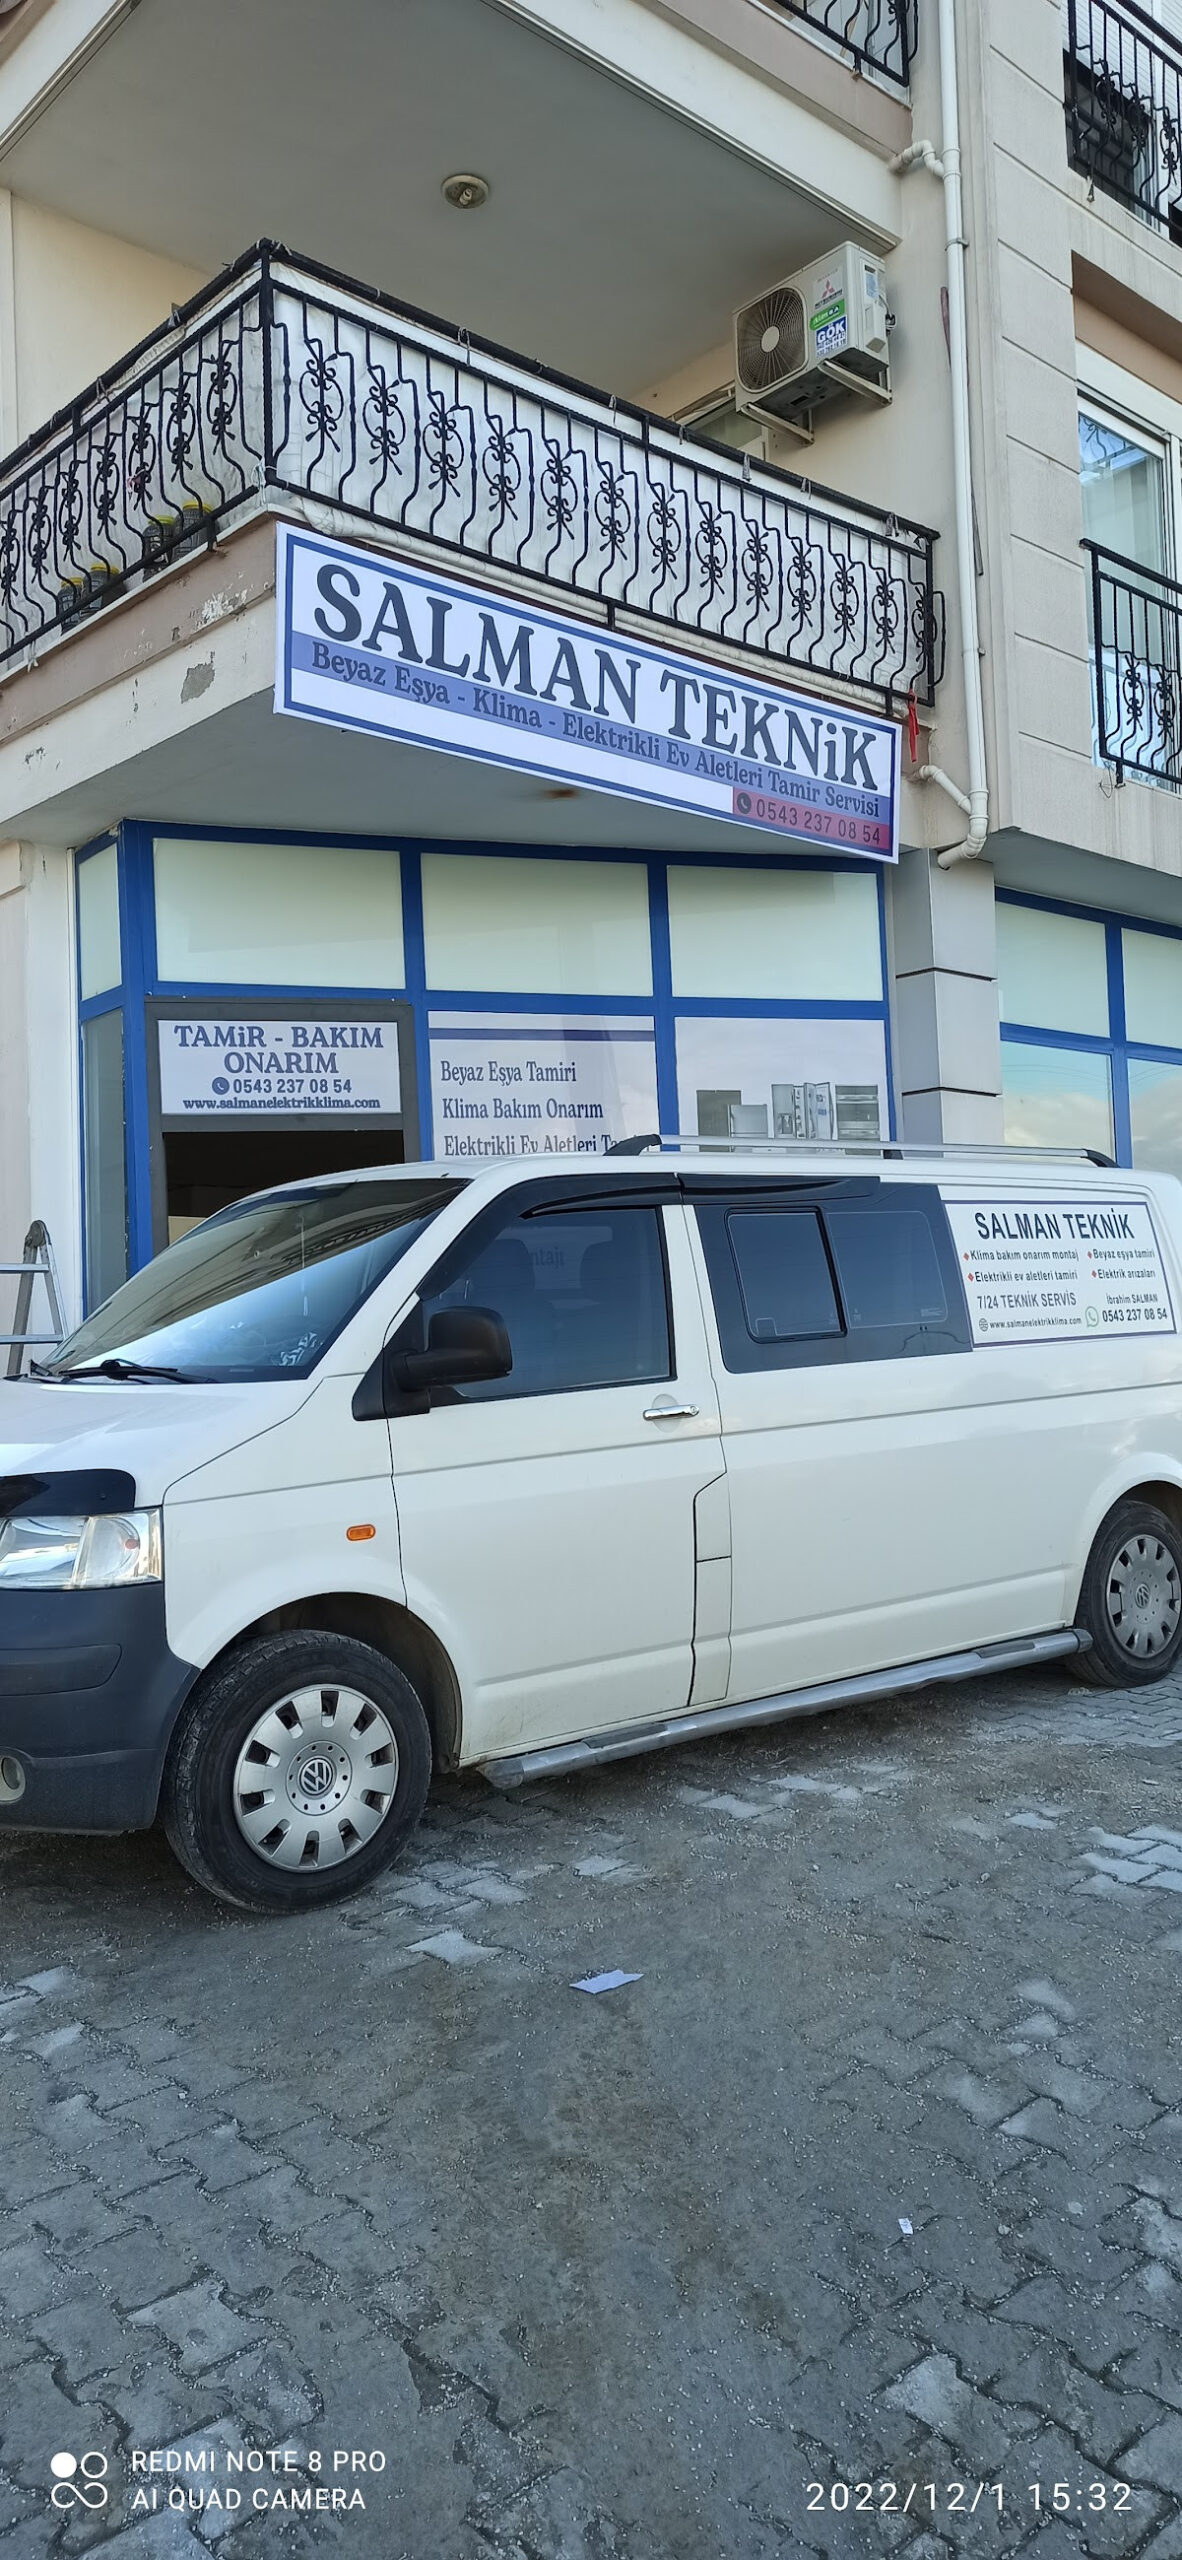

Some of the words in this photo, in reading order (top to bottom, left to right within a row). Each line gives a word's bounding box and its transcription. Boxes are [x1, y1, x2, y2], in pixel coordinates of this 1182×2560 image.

[817, 320, 845, 343] GÖK
[314, 564, 641, 724] SALMAN
[311, 640, 386, 687] Beyaz
[394, 664, 450, 704] Eşya
[473, 687, 542, 728] Klima
[562, 712, 660, 761] Elektrikli
[666, 741, 690, 767] Ev
[694, 751, 764, 788] Aletleri
[768, 770, 821, 803] Tamir
[825, 786, 880, 818] Servisi
[756, 798, 798, 827] 0543
[803, 810, 833, 833] 237
[838, 819, 857, 841] 08
[862, 824, 881, 846] 54
[291, 1026, 384, 1048] BAKIM
[224, 1052, 339, 1074] ONARIM
[440, 1060, 484, 1086] Beyaz
[488, 1061, 523, 1086] Eşya
[526, 1061, 577, 1082] Tamiri
[233, 1078, 272, 1094] 0543
[276, 1078, 304, 1094] 237
[309, 1078, 328, 1094] 08
[333, 1078, 352, 1094] 54
[183, 1097, 381, 1109] www.salmanelektrikklima.com
[442, 1098, 489, 1119] Klima
[493, 1098, 542, 1119] Bakım
[546, 1098, 604, 1119] Onarım
[444, 1135, 515, 1156] Elektrikli
[520, 1135, 539, 1154] Ev
[543, 1135, 597, 1153] Aletleri
[974, 1212, 1062, 1240] SALMAN
[1063, 1208, 1135, 1240] TEKNİK
[970, 1250, 995, 1261] Klima
[996, 1250, 1021, 1261] bakım
[1022, 1250, 1051, 1260] onarım
[1052, 1249, 1080, 1262] montaj
[1092, 1248, 1116, 1261] Beyaz
[1116, 1249, 1134, 1261] eşya
[1134, 1248, 1155, 1258] tamiri
[974, 1271, 1013, 1282] Elektrikli
[1014, 1273, 1024, 1281] ev
[1025, 1271, 1054, 1281] aletleri
[1054, 1269, 1078, 1280] tamiri
[1097, 1268, 1127, 1279] Elektrik
[1000, 1290, 1040, 1309] TEKNİK
[1040, 1288, 1077, 1307] SERVİS
[1131, 1293, 1158, 1304] SALMAN
[989, 1317, 1082, 1329] www.salmanelektrikklima.com
[1102, 1308, 1125, 1322] 0543
[1126, 1308, 1142, 1321] 237
[1144, 1307, 1156, 1321] 08
[1156, 1307, 1168, 1320] 54
